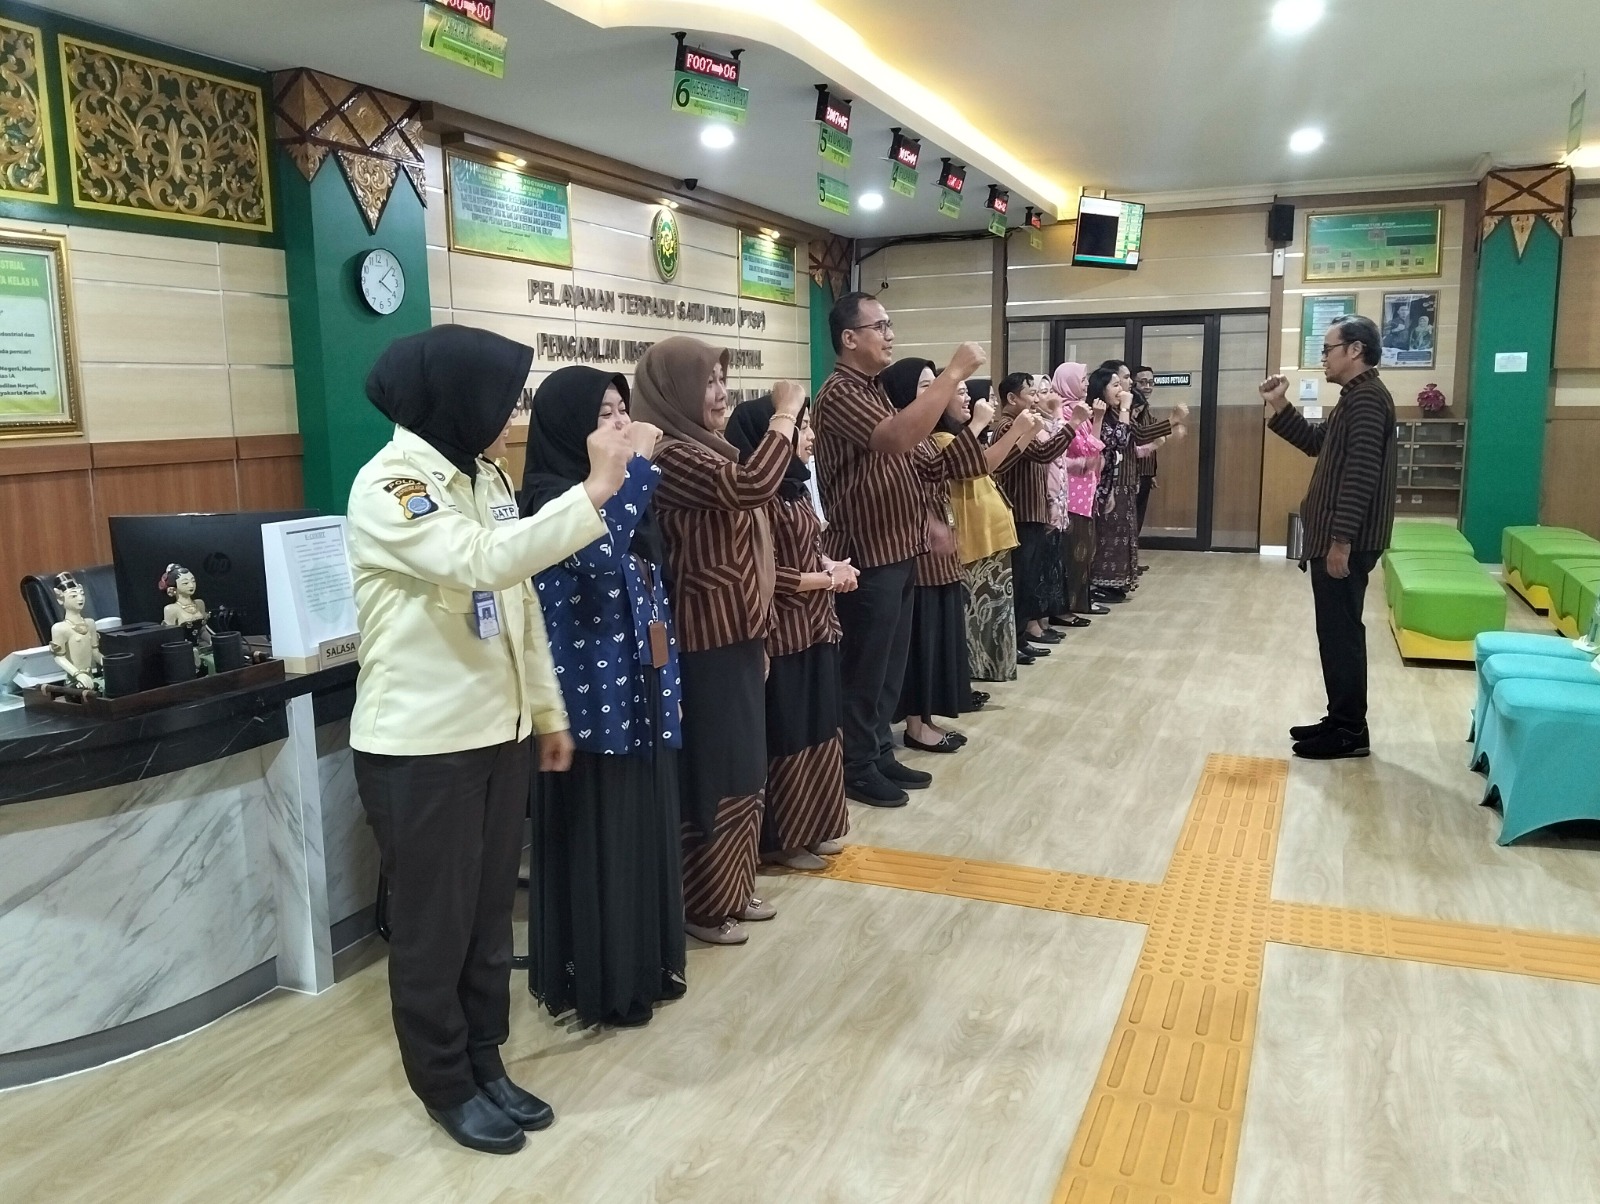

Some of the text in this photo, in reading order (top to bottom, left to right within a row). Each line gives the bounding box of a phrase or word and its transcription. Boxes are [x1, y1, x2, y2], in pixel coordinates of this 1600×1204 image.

[686, 53, 736, 80] F007 06
[676, 78, 691, 108] 6
[820, 128, 828, 152] 5
[819, 178, 826, 202] 5
[8, 276, 30, 286] KELAS
[528, 279, 615, 313] PELAYANAN
[617, 292, 675, 319] TERPADU
[326, 642, 356, 658] SALASA
